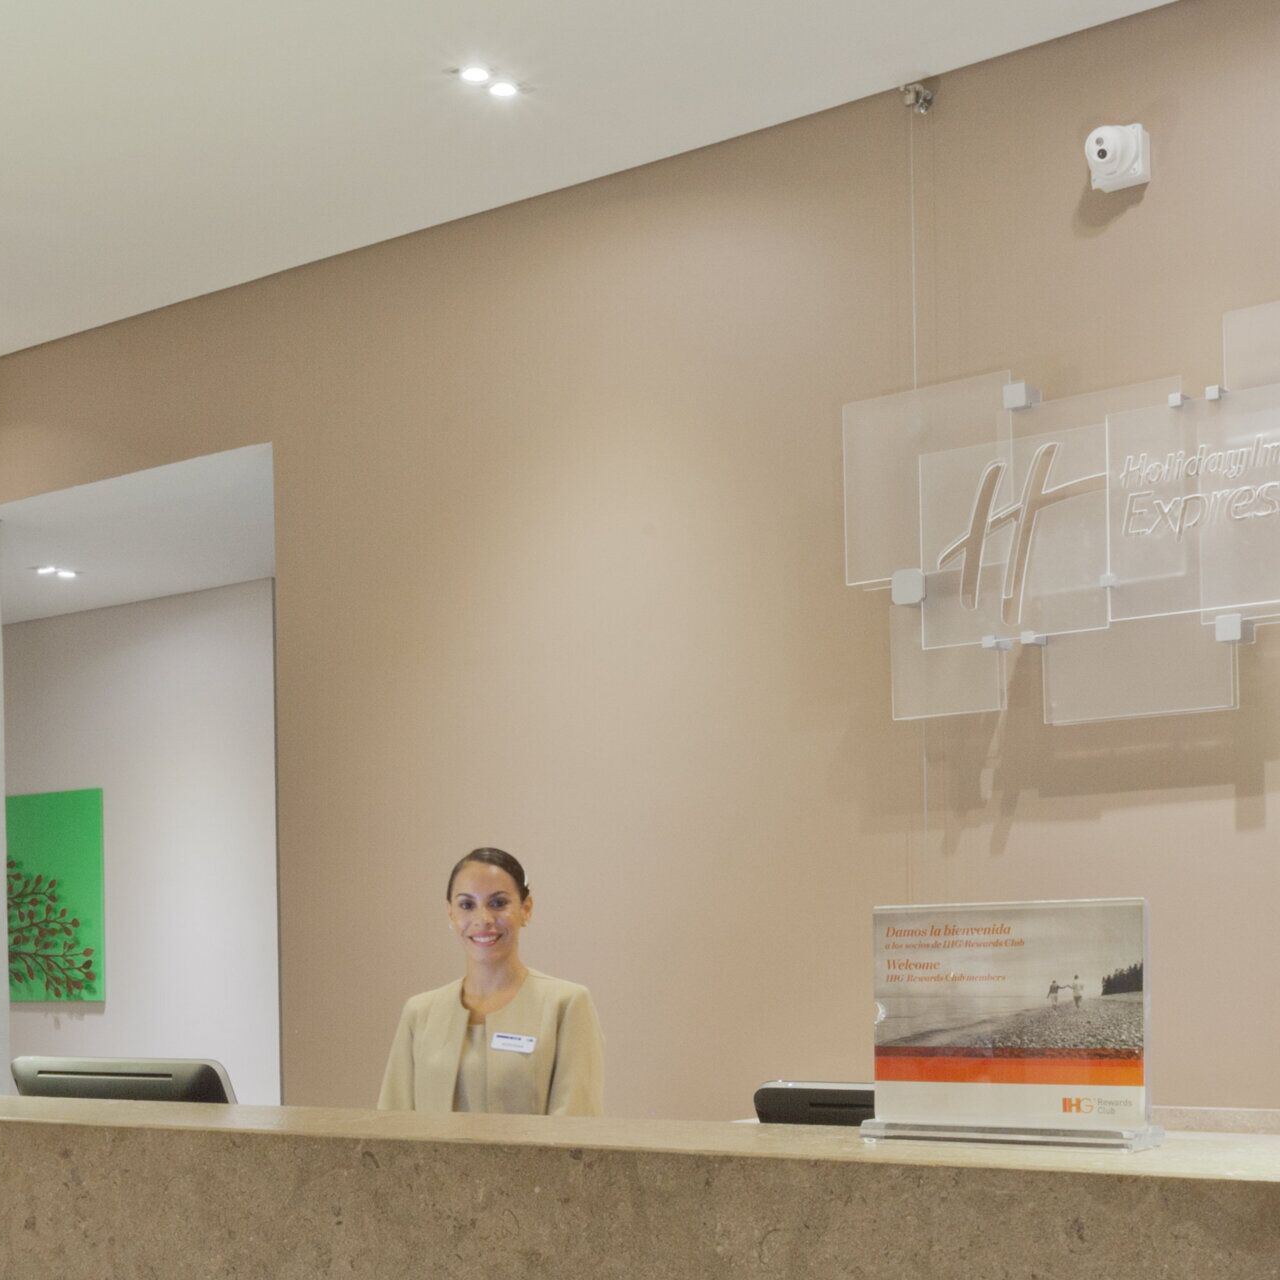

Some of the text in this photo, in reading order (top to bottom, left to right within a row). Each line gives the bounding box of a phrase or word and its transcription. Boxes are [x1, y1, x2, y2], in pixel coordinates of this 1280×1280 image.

[1120, 444, 1251, 488] Holiday
[885, 923, 1011, 938] Damos la bienvenida
[965, 940, 1003, 948] Rewards
[1005, 938, 1024, 947] Club
[886, 959, 940, 970] Welcome
[907, 974, 944, 982] Rewards
[945, 973, 964, 981] Club
[966, 973, 1006, 981] members
[1062, 1097, 1132, 1113] IHG Rewards
[1097, 1106, 1116, 1114] Club
